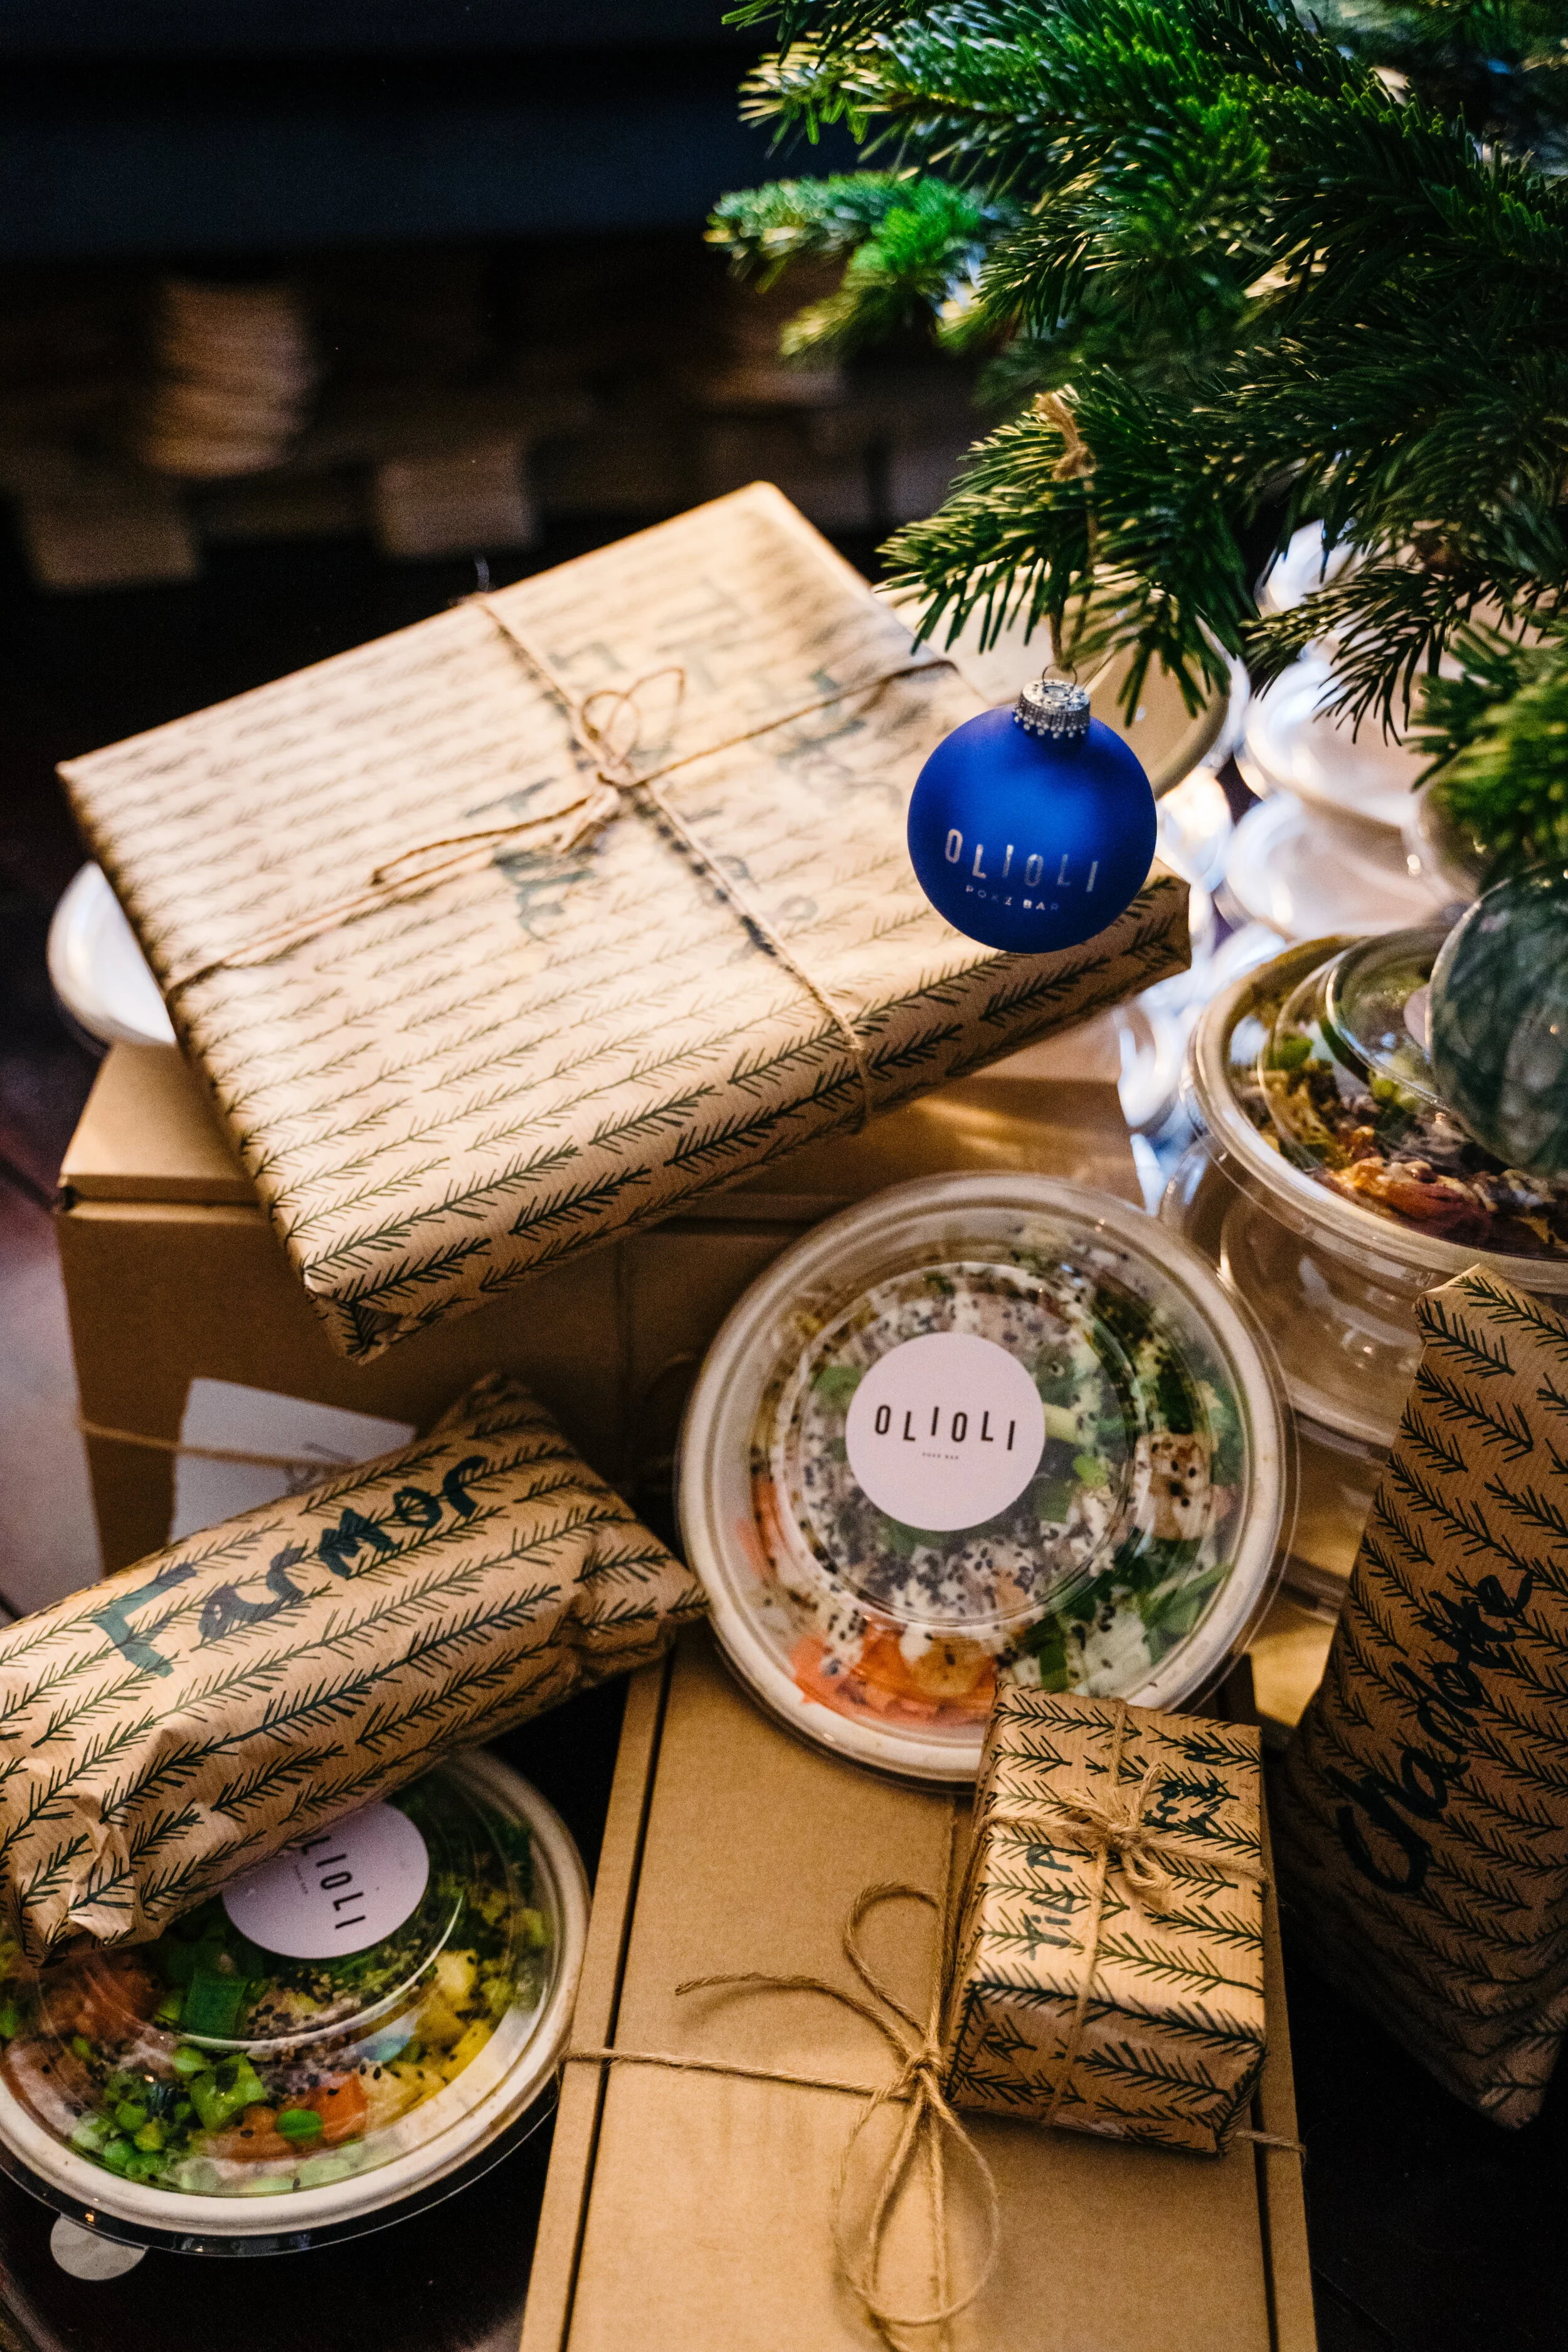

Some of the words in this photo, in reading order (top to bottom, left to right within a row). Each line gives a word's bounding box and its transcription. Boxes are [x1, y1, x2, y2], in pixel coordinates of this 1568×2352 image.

[945, 829, 1098, 893] OLIOLI
[874, 1404, 1015, 1451] OLIOLI
[302, 1836, 366, 1929] LIOLI
